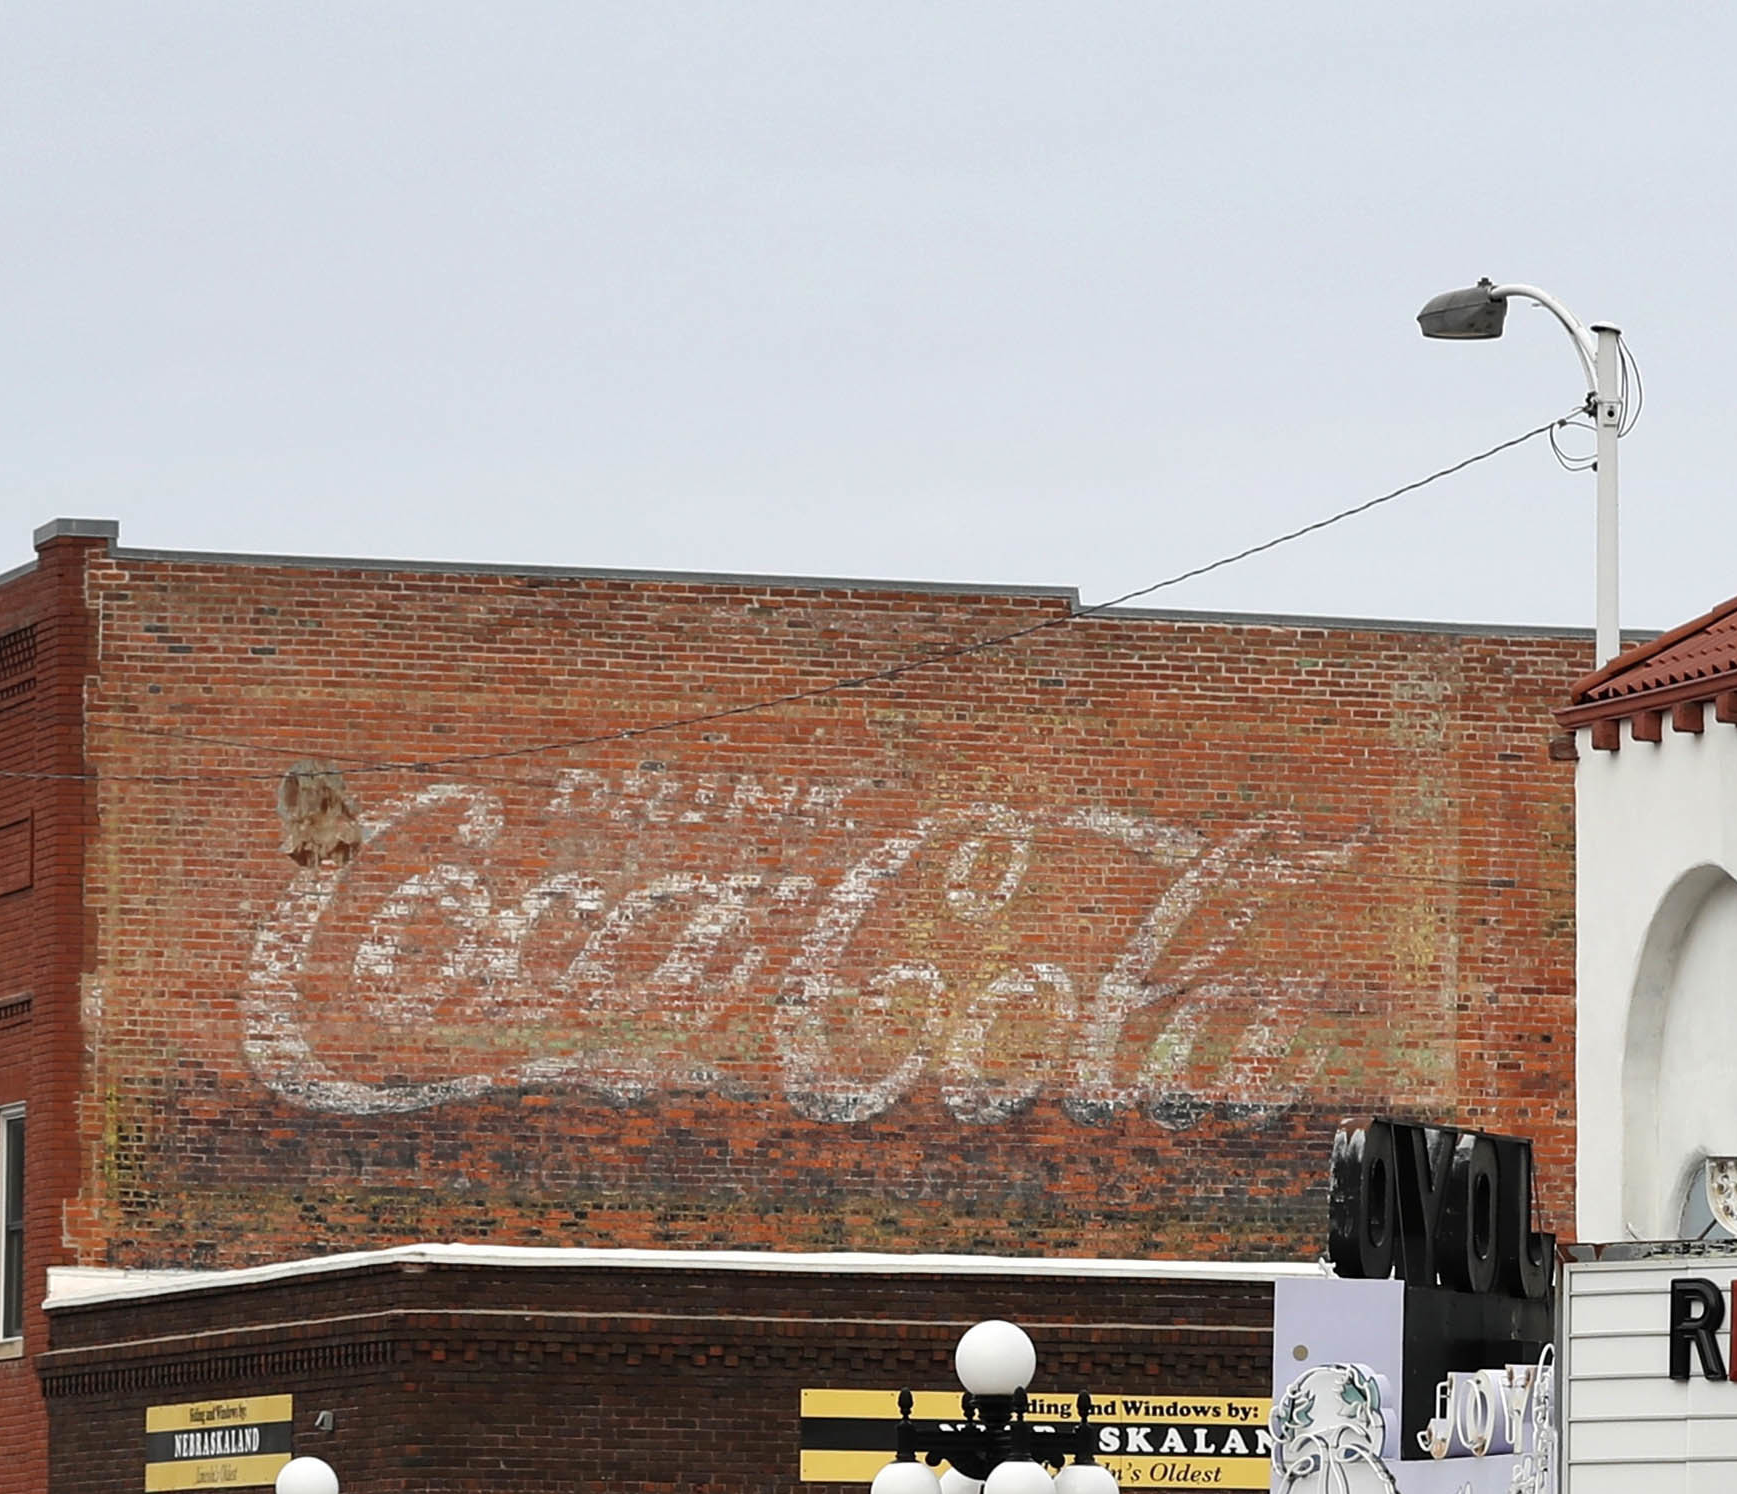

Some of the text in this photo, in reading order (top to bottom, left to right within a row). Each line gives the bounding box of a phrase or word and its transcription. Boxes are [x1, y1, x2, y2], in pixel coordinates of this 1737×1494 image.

[1122, 1400, 1222, 1418] Windows
[1227, 1402, 1259, 1421] by:
[173, 1427, 261, 1458] NEBRASKALAND
[1149, 1462, 1222, 1483] Oldest
